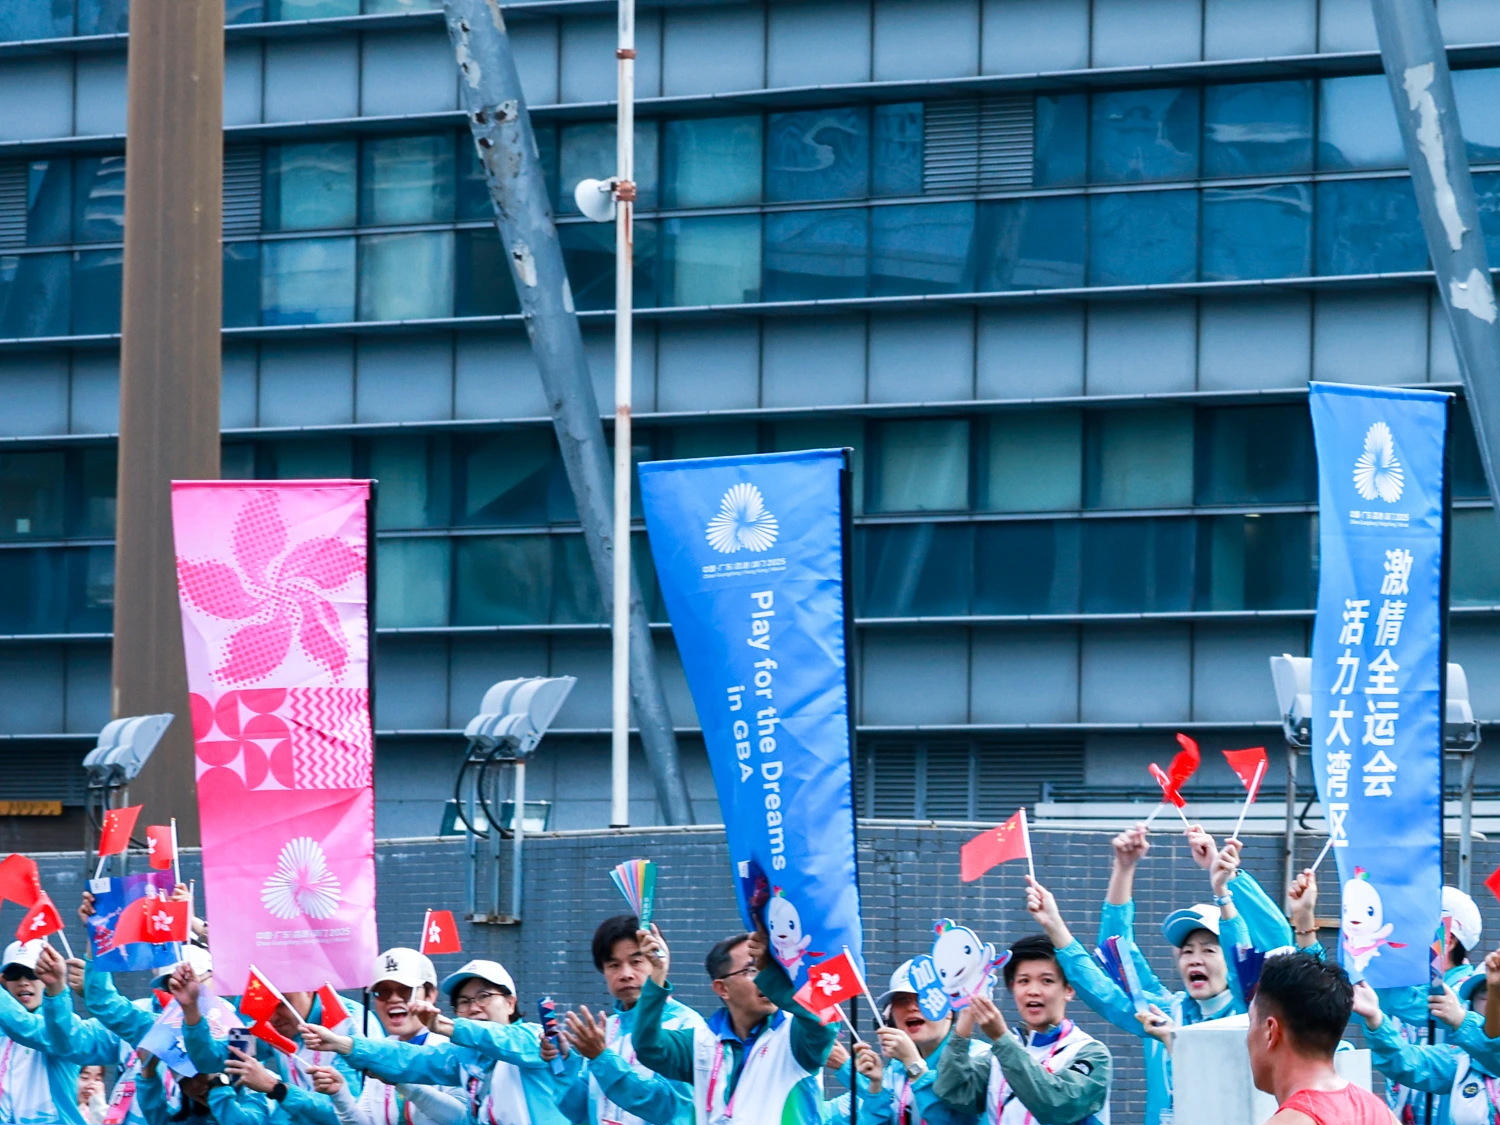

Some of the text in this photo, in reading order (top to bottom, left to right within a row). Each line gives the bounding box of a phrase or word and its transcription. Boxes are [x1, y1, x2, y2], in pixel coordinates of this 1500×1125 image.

[726, 684, 752, 783] in GBA
[747, 590, 786, 872] Play for the Dreams
[1325, 597, 1371, 848] 活力大湾区
[1361, 548, 1414, 798] 激情全运会
